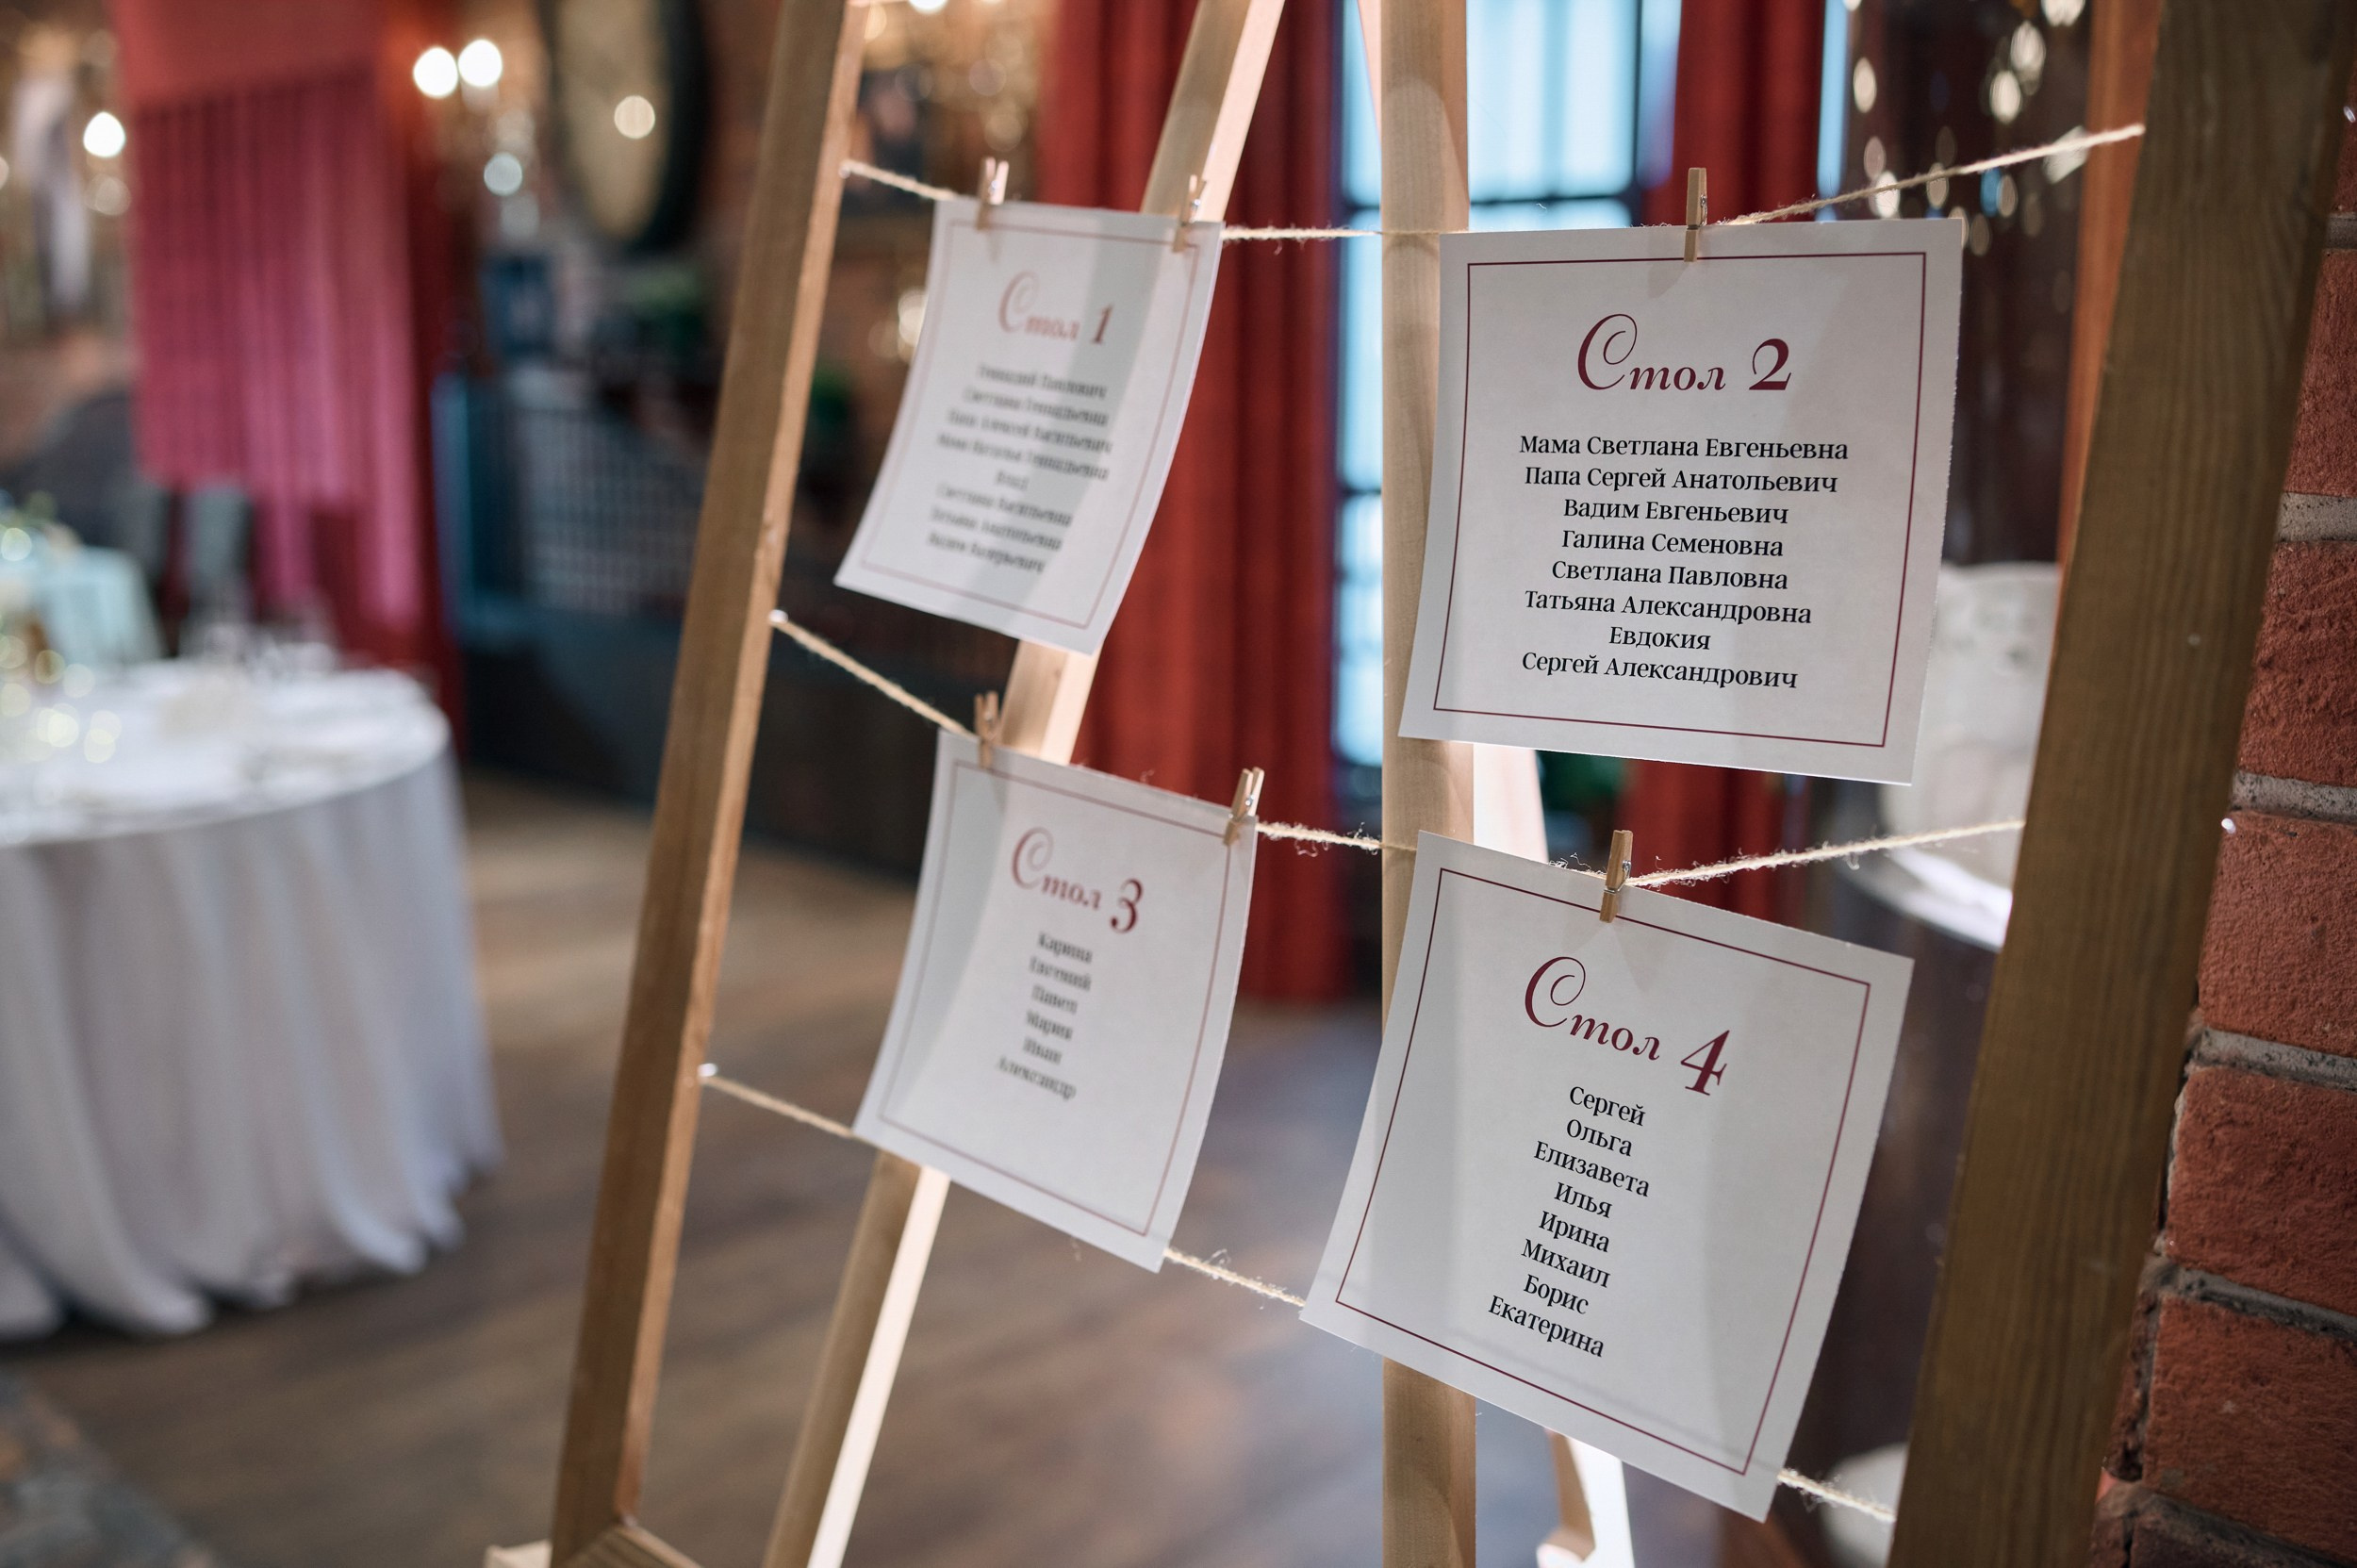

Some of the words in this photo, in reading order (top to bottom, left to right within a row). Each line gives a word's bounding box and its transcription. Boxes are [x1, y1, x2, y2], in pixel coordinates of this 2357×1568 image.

[999, 272, 1080, 339] Стол
[1090, 305, 1113, 343] 1
[1578, 314, 1725, 390] Стол
[1749, 338, 1791, 390] 2
[1520, 436, 1580, 454] Мама
[1588, 437, 1699, 456] Светлана
[1706, 438, 1848, 459] Евгеньевна
[1525, 467, 1580, 485] Папа
[1588, 468, 1666, 491] Сергей
[1672, 470, 1838, 492] Анатольевич
[1564, 499, 1640, 520] Вадим
[1645, 502, 1788, 523] Евгеньевич
[1562, 530, 1644, 551] Галина
[1652, 534, 1783, 556] Семеновна
[1553, 561, 1661, 583] Светлана
[1668, 567, 1788, 589] Павловна
[1525, 591, 1615, 612] Татьяна
[1621, 596, 1811, 625] Александровна
[1609, 627, 1711, 650] Евдокия
[1523, 652, 1599, 676] Сергей
[1604, 658, 1798, 688] Александрович
[1012, 828, 1101, 910] Стол
[1111, 879, 1143, 933] 3
[1525, 957, 1659, 1061] Стол
[1681, 1031, 1729, 1096] 4
[1570, 1087, 1645, 1126] Сергей
[1567, 1119, 1631, 1156] Ольга
[1534, 1141, 1649, 1197] Елизавета
[1554, 1182, 1612, 1218] Илья
[1539, 1211, 1608, 1252] Ирина
[1521, 1239, 1610, 1288] Михаил
[1524, 1274, 1589, 1313] Борис
[1489, 1296, 1604, 1357] Екатерина
